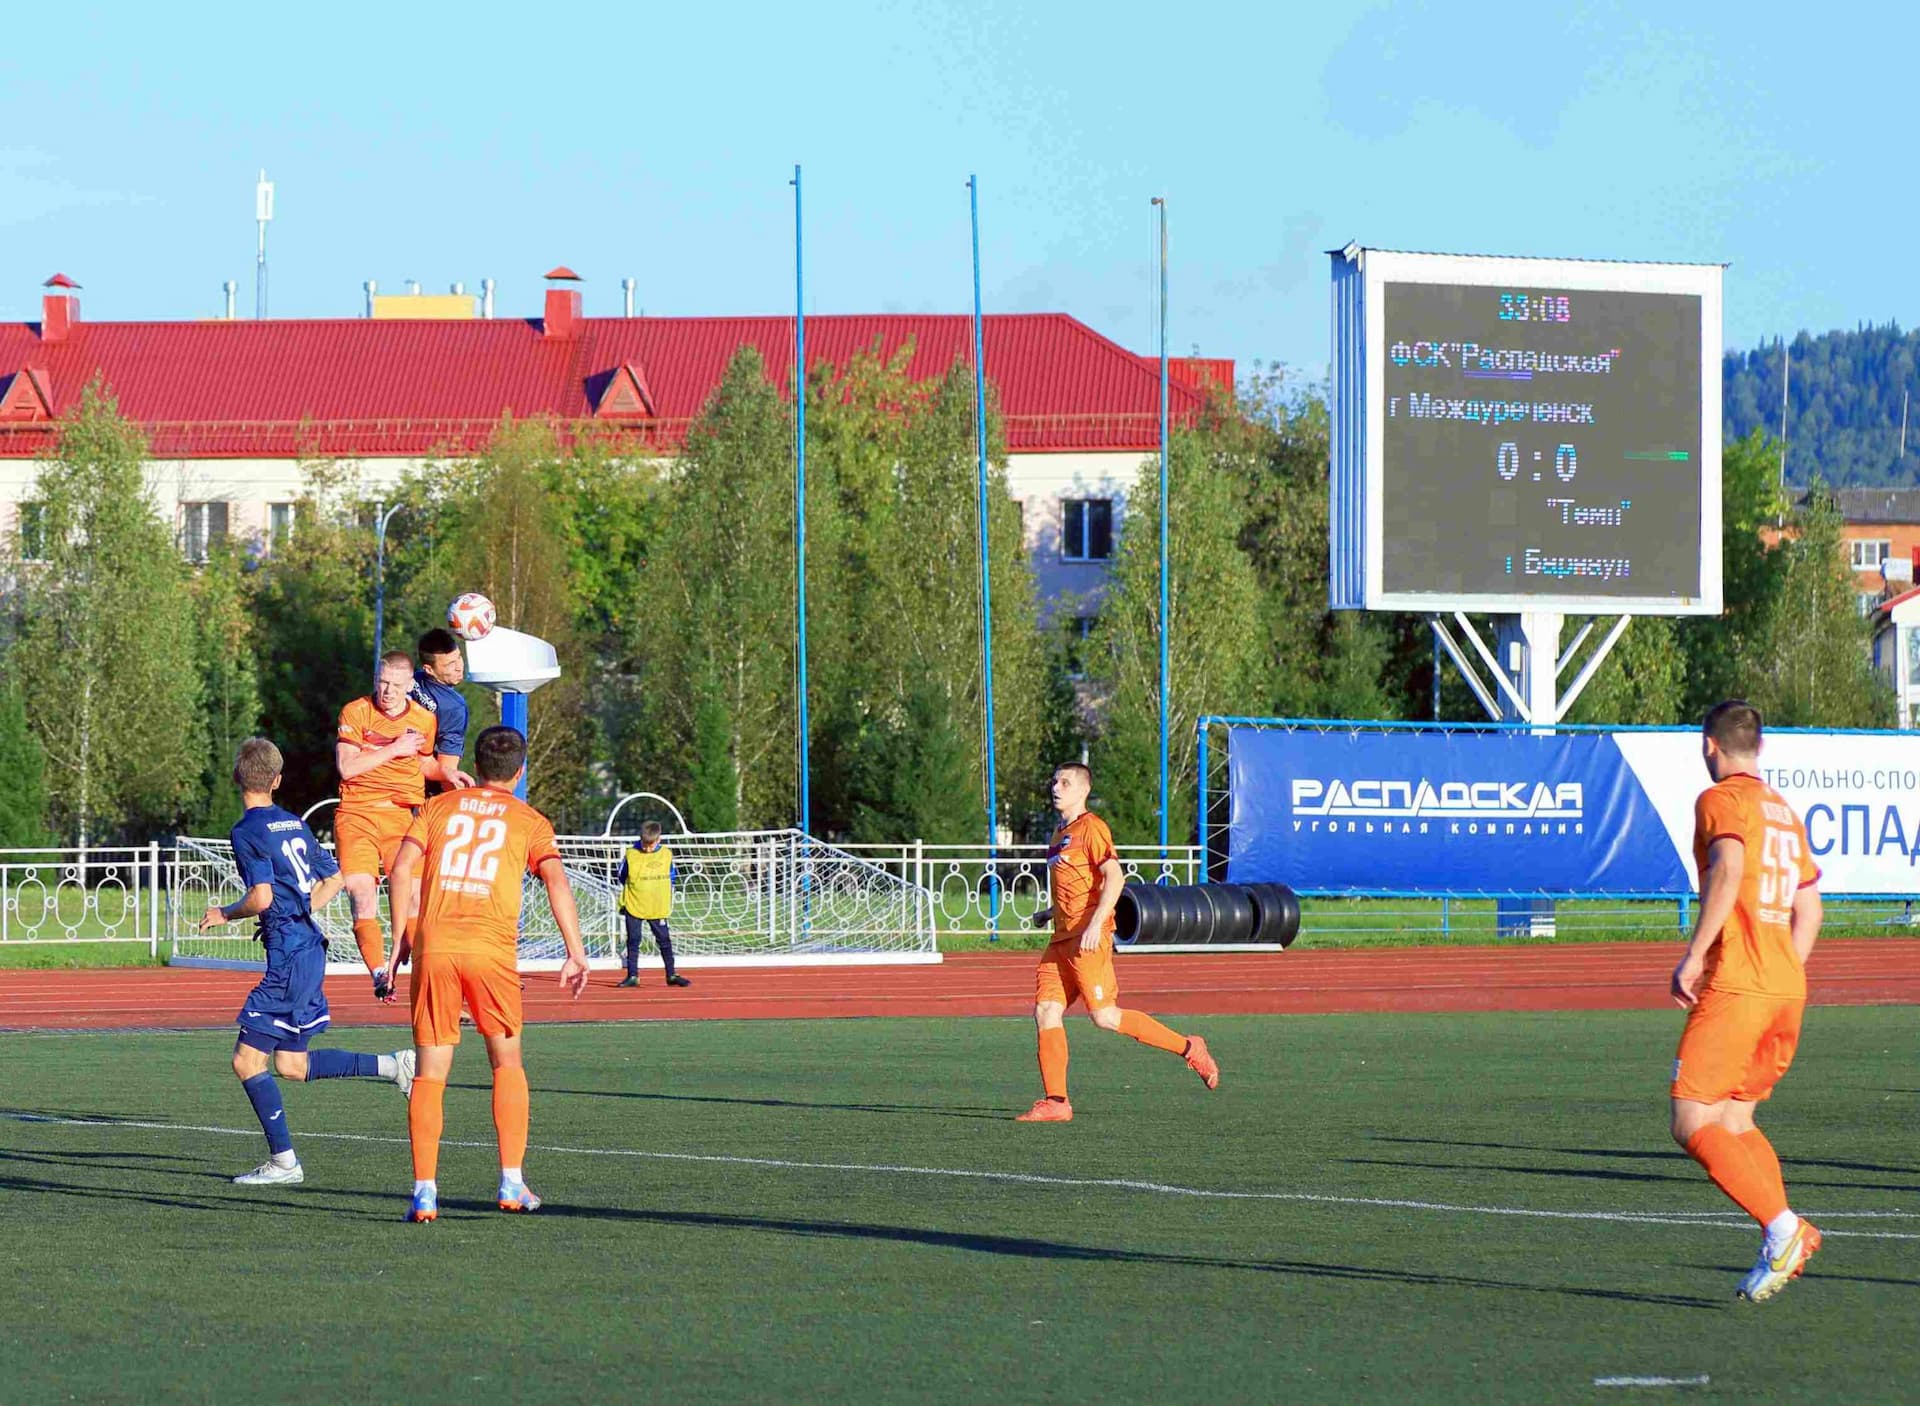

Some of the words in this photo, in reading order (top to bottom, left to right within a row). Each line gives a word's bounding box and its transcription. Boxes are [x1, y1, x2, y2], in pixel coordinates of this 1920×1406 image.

[1292, 778, 1583, 818] РАСПАДСКАЯ
[1759, 769, 1920, 790] ТБОЛЬНО-СПО
[440, 814, 507, 882] 22
[1292, 820, 1429, 833] УГОЛЬНАЯ
[1451, 822, 1584, 835] КОМПАНИЯ
[1804, 803, 1920, 867] СПА
[1759, 826, 1801, 908] 55
